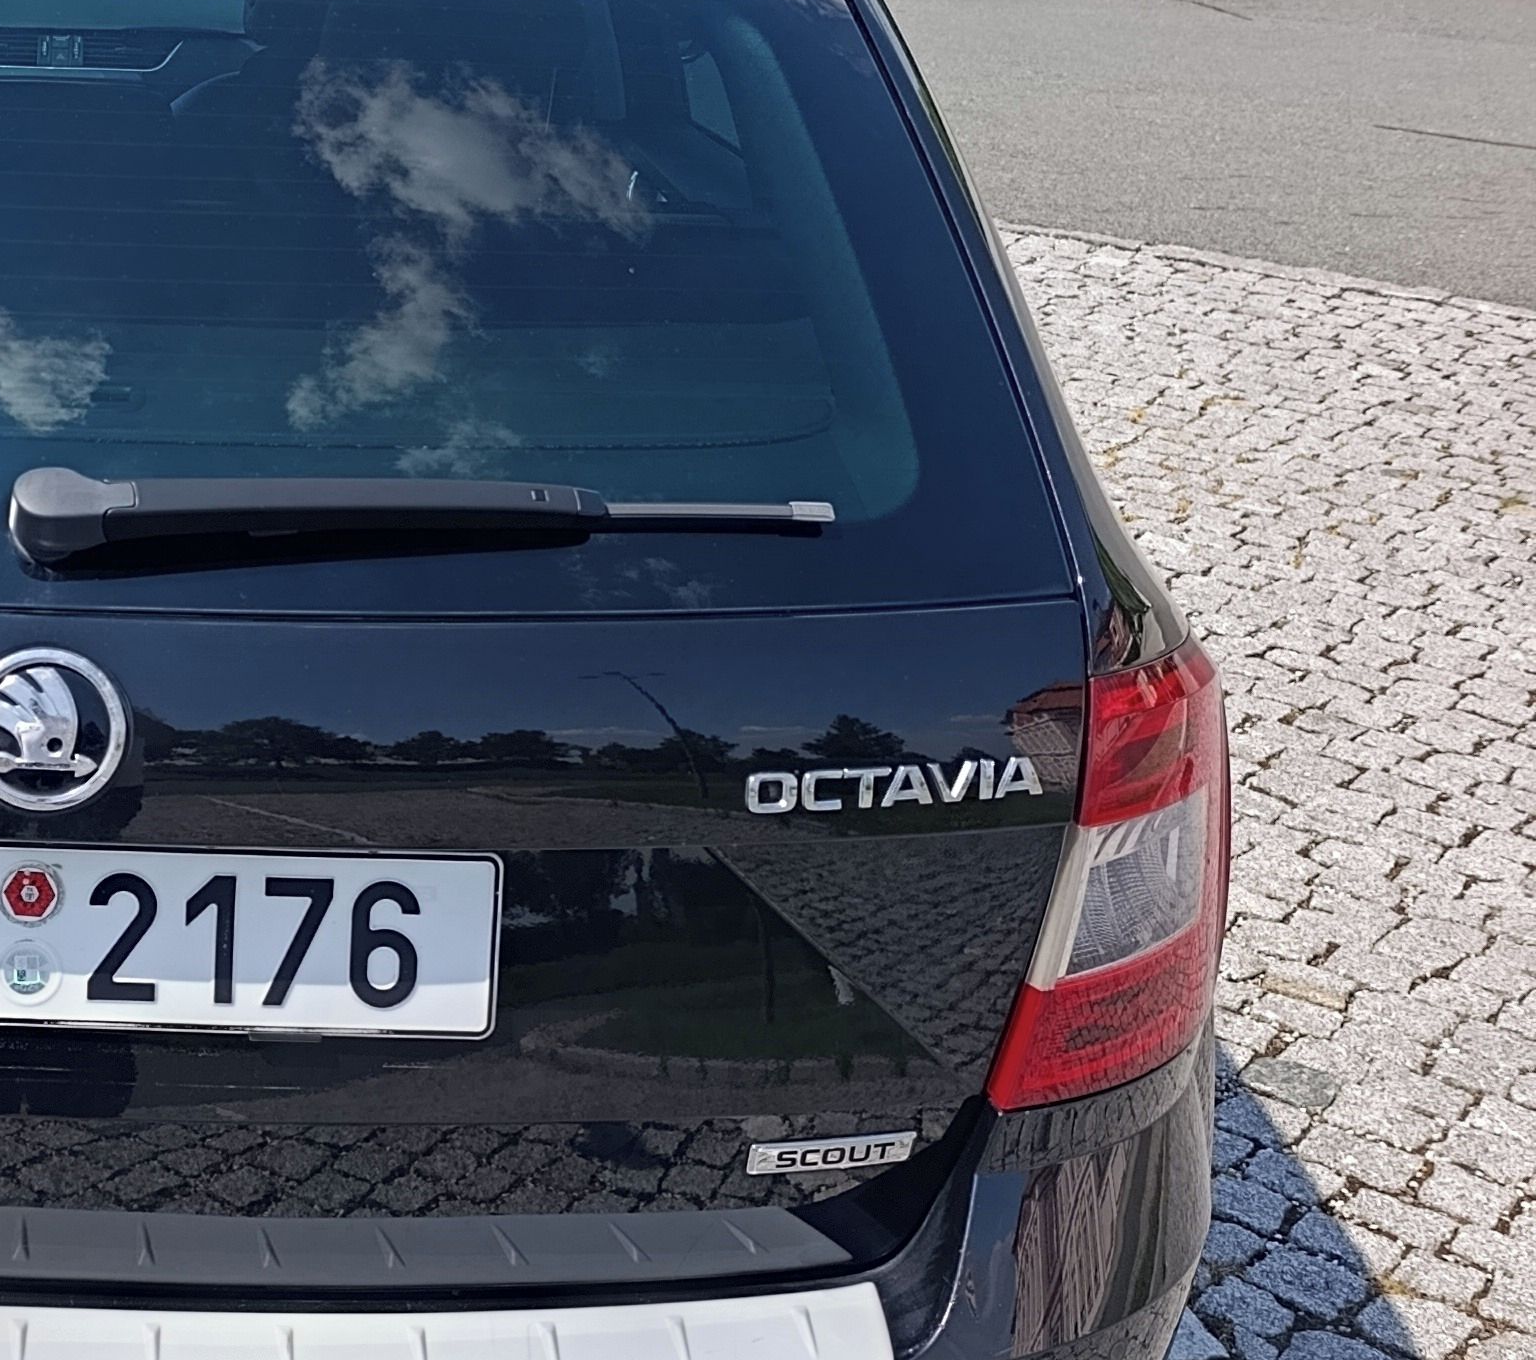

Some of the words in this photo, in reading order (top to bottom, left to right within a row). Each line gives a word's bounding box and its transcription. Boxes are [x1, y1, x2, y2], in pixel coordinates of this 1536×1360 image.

[745, 756, 1044, 814] OCTAVIA
[86, 870, 421, 1009] 2176
[776, 1142, 895, 1168] SCOUT
